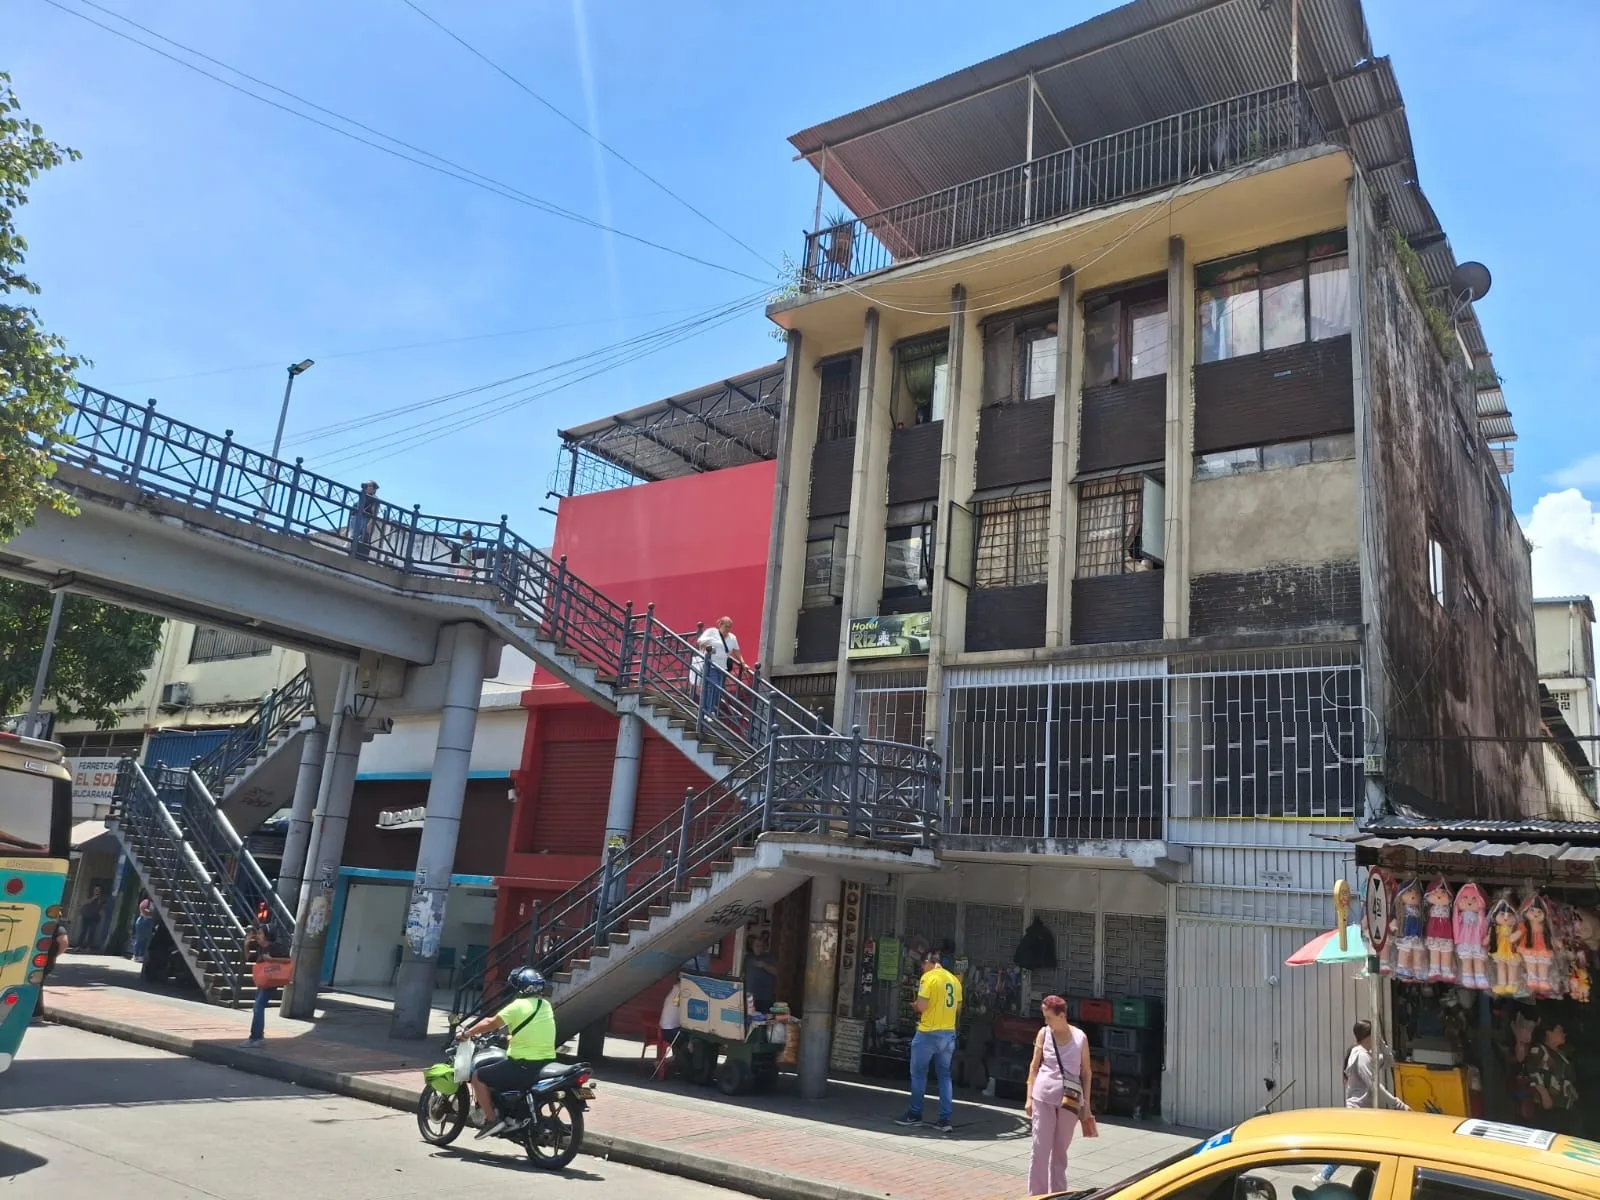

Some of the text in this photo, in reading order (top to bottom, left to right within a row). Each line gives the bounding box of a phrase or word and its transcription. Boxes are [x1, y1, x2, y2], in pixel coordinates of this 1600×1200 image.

[852, 621, 878, 631] Hotel
[75, 772, 116, 787] EL SOL
[944, 982, 955, 1009] 3
